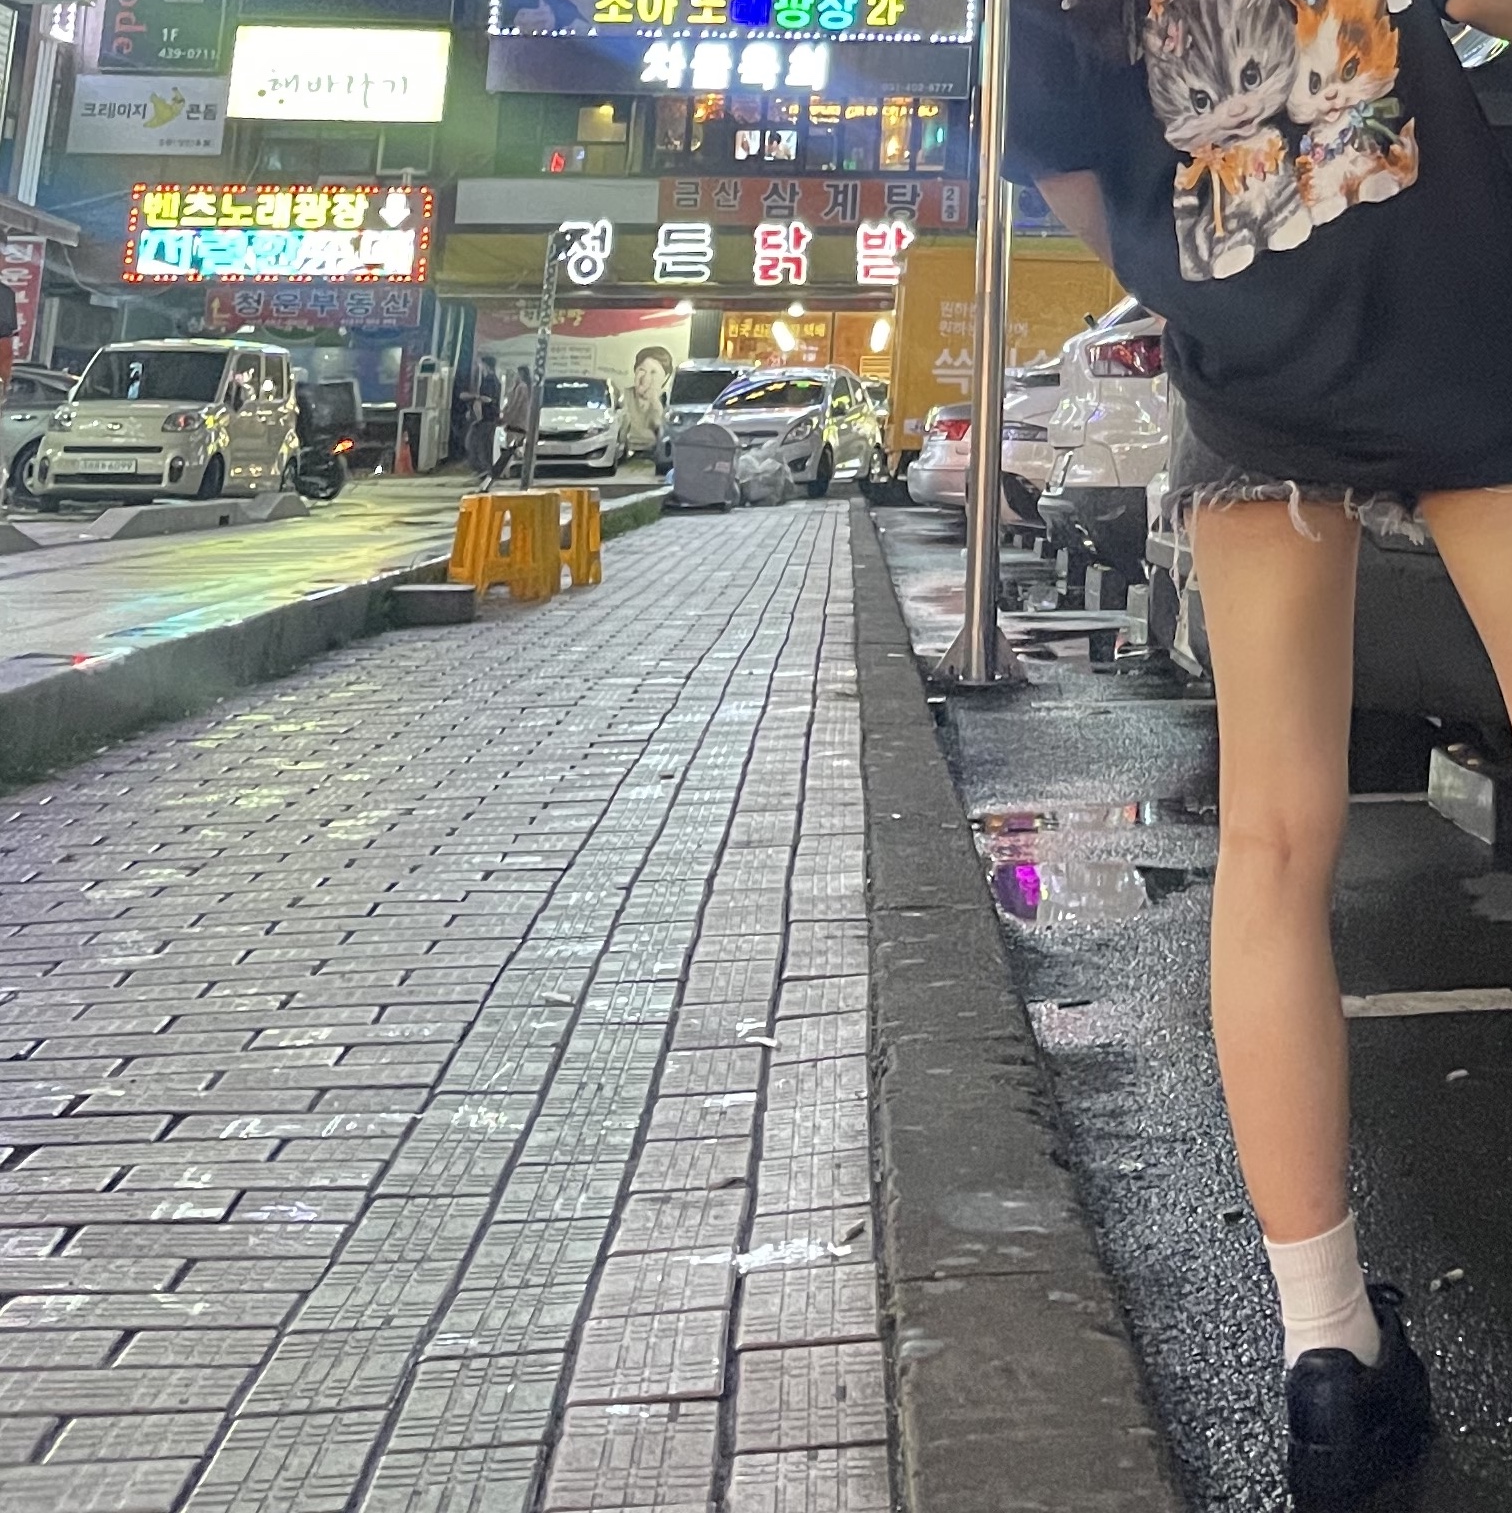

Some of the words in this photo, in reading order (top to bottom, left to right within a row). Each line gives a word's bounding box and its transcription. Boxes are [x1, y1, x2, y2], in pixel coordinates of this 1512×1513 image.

[161, 27, 179, 43] 1F
[267, 67, 410, 110] 해바라기
[80, 101, 148, 120] 크레이지
[143, 191, 370, 230] 벤츠노래광장
[672, 179, 743, 211] 금산
[761, 180, 925, 223] 삼계탕
[233, 289, 414, 319] 청운부동산
